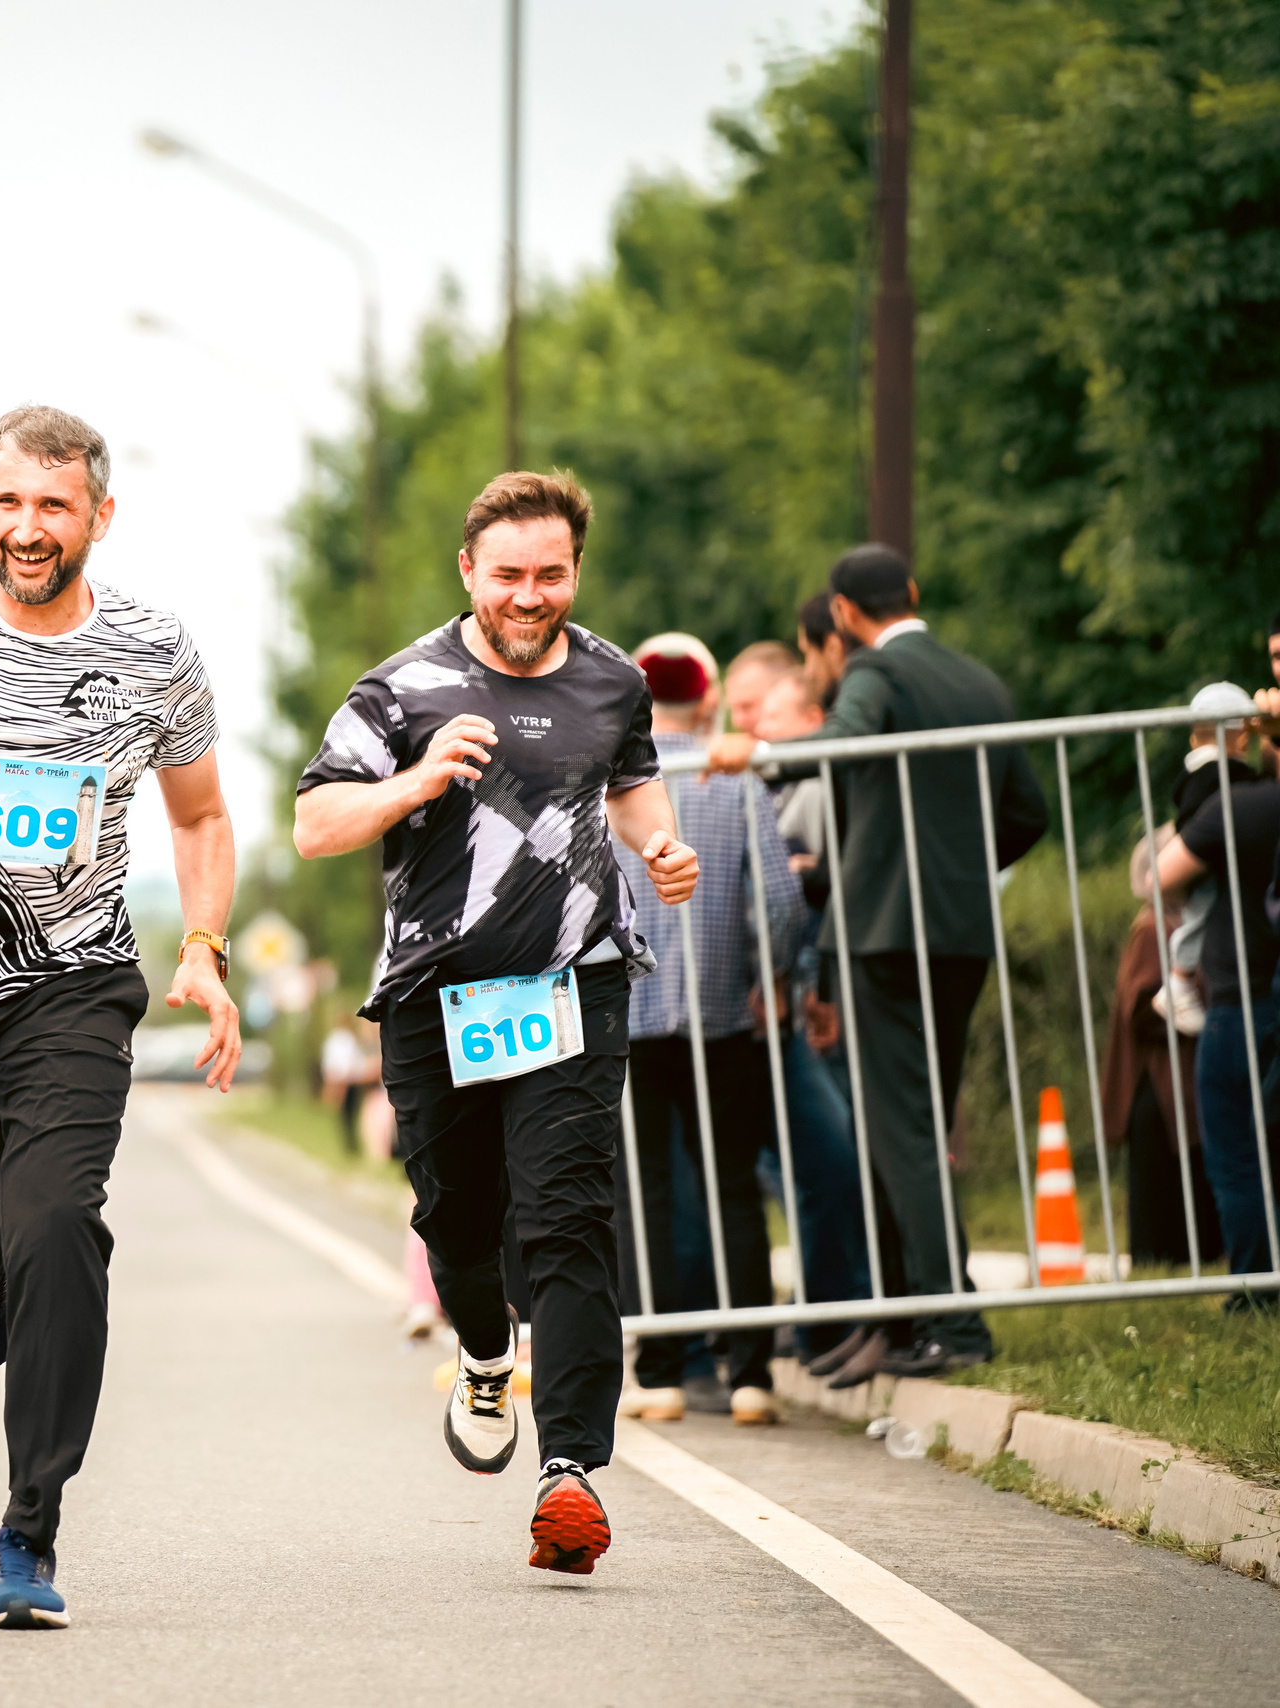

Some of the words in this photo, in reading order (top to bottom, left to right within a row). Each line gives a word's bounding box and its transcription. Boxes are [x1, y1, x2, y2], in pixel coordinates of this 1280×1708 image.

[89, 684, 142, 698] DAGESTAN
[88, 695, 132, 710] WILD
[90, 710, 117, 721] trail
[510, 714, 540, 727] VTR
[5, 768, 30, 776] МАГАС
[480, 985, 503, 994] МАГАС
[461, 1013, 552, 1063] 610
